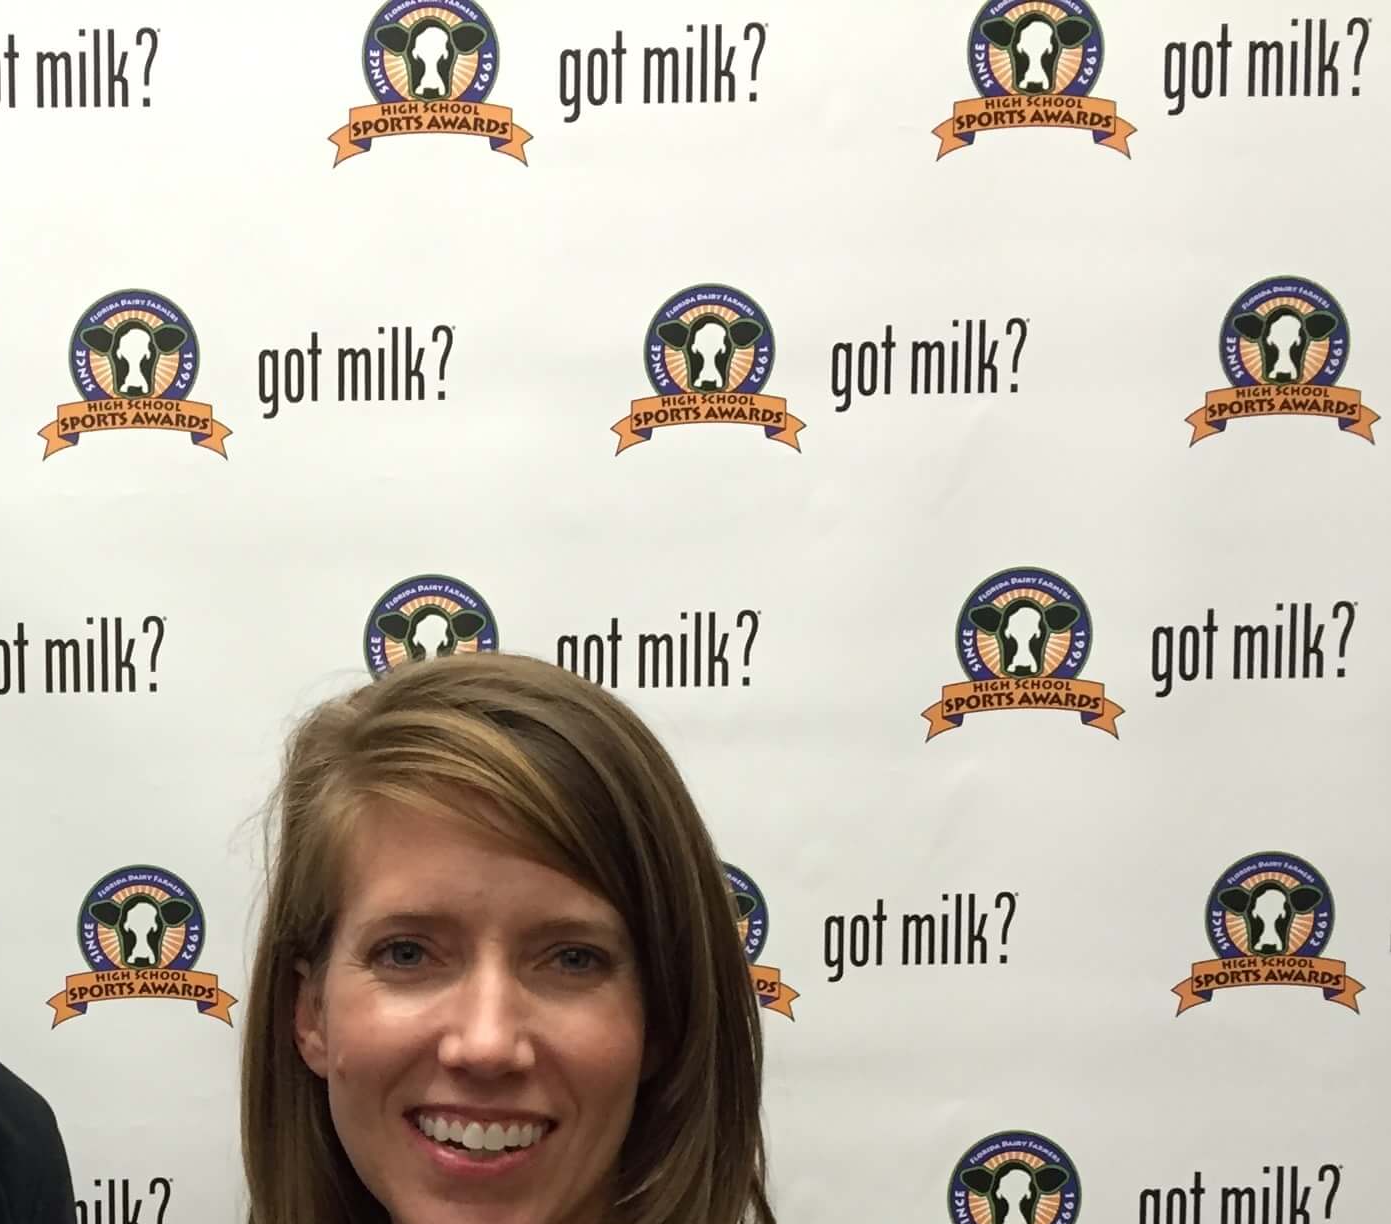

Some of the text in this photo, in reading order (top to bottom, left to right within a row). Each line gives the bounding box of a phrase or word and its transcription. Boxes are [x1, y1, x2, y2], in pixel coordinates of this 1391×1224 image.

[37, 28, 158, 108] milk?
[560, 22, 765, 123] got milk?
[1164, 17, 1369, 116] got milk?
[381, 103, 479, 116] HIGH SCHOOL
[985, 97, 1083, 109] HIGH SCHOOL
[352, 115, 509, 136] SPORTS AWARDS
[956, 109, 1112, 130] SPORTS AWARDS
[76, 350, 95, 392] SINCE
[175, 353, 194, 389] 1992
[259, 325, 453, 419] got milk?
[832, 318, 1027, 412] got milk?
[662, 395, 755, 407] HIGH SCHOOL
[1236, 386, 1329, 398] HIGH SCHOOL
[88, 400, 181, 412] HIGH SCHOOL
[633, 406, 783, 427] SPORTS AWARDS
[1208, 398, 1357, 418] SPORTS AWARDS
[60, 412, 209, 432] SPORTS AWARDS
[46, 616, 164, 693] milk?
[639, 610, 759, 688] milk?
[962, 629, 982, 672] SINCE
[1066, 631, 1086, 668] 1992
[1152, 601, 1358, 697] got milk?
[973, 680, 1071, 692] HIGH SCHOOL
[944, 692, 1100, 713] SPORTS AWARDS
[84, 923, 103, 963] SINCE
[181, 926, 199, 960] 1992
[824, 892, 1016, 982] got milk?
[1222, 958, 1314, 969] HIGH SCHOOL
[96, 971, 187, 982] HIGH SCHOOL
[1194, 969, 1342, 988] SPORTS AWARDS
[69, 982, 215, 1001] SPORTS AWARDS
